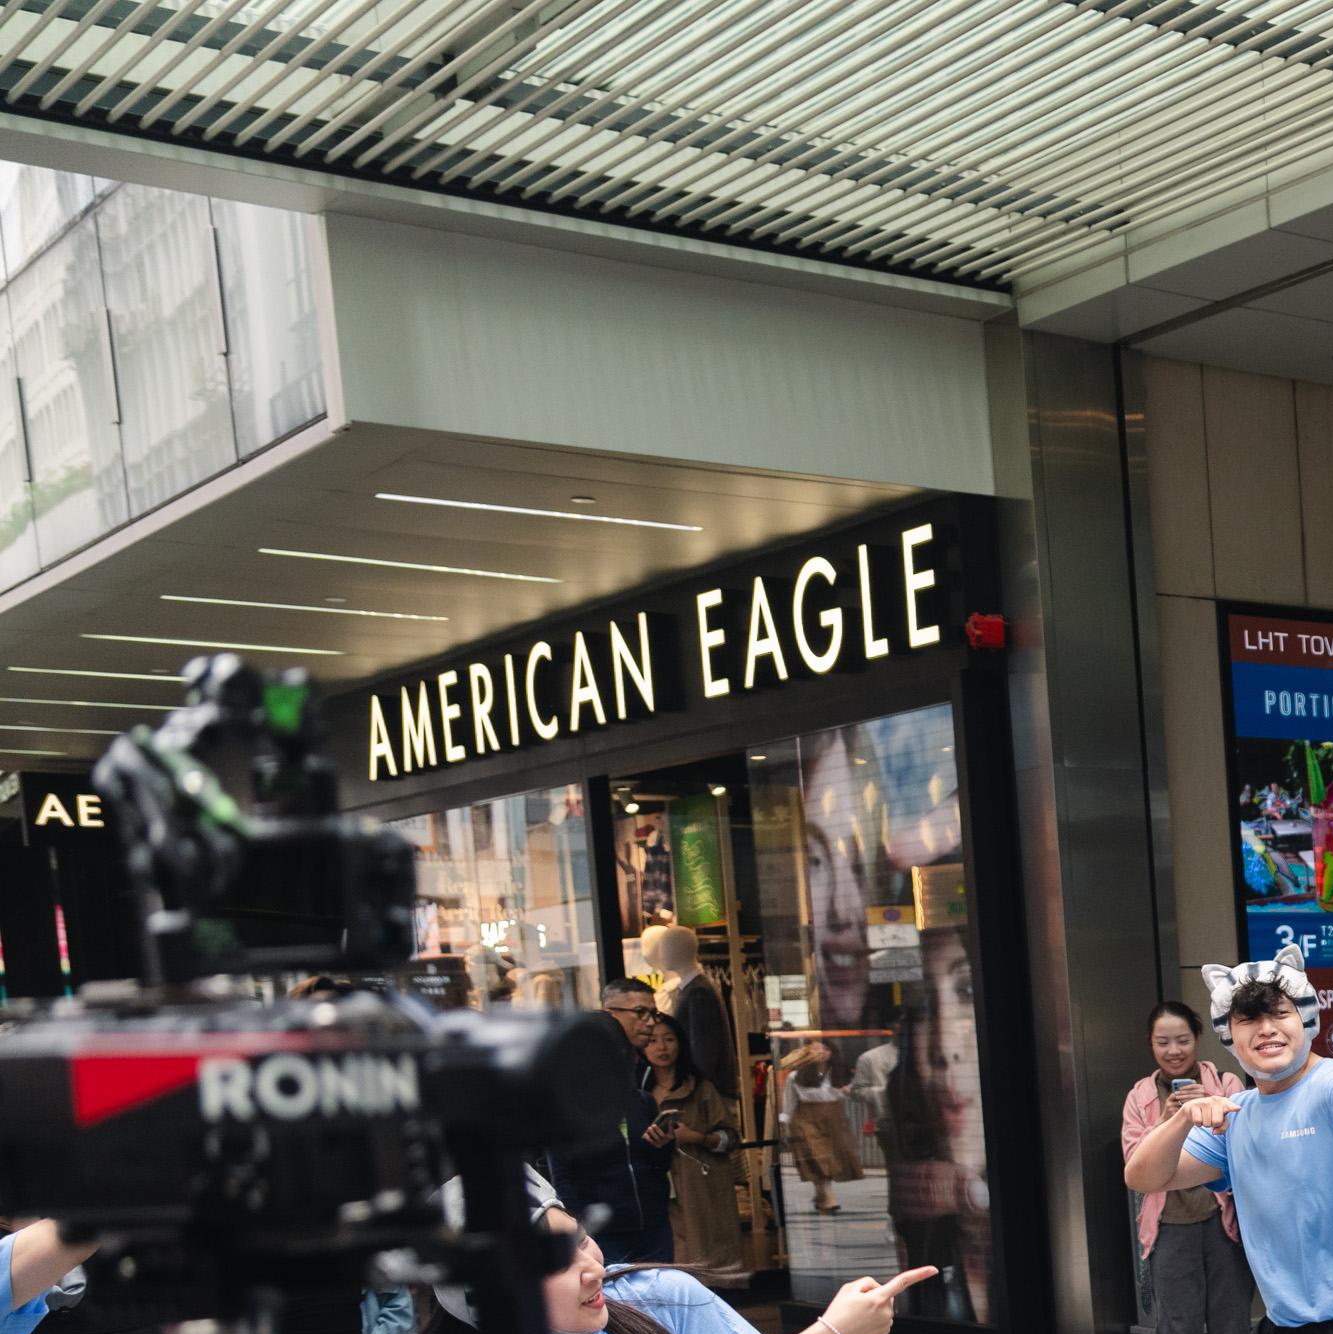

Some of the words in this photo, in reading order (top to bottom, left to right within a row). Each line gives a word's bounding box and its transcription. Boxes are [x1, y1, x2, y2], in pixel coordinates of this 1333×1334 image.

[367, 611, 655, 782] AMERICAN
[697, 524, 940, 699] EAGLE
[1244, 629, 1288, 653] LHT
[35, 793, 104, 827] AE
[200, 1055, 420, 1122] RONIN
[1280, 1126, 1317, 1140] SAMSUNG
